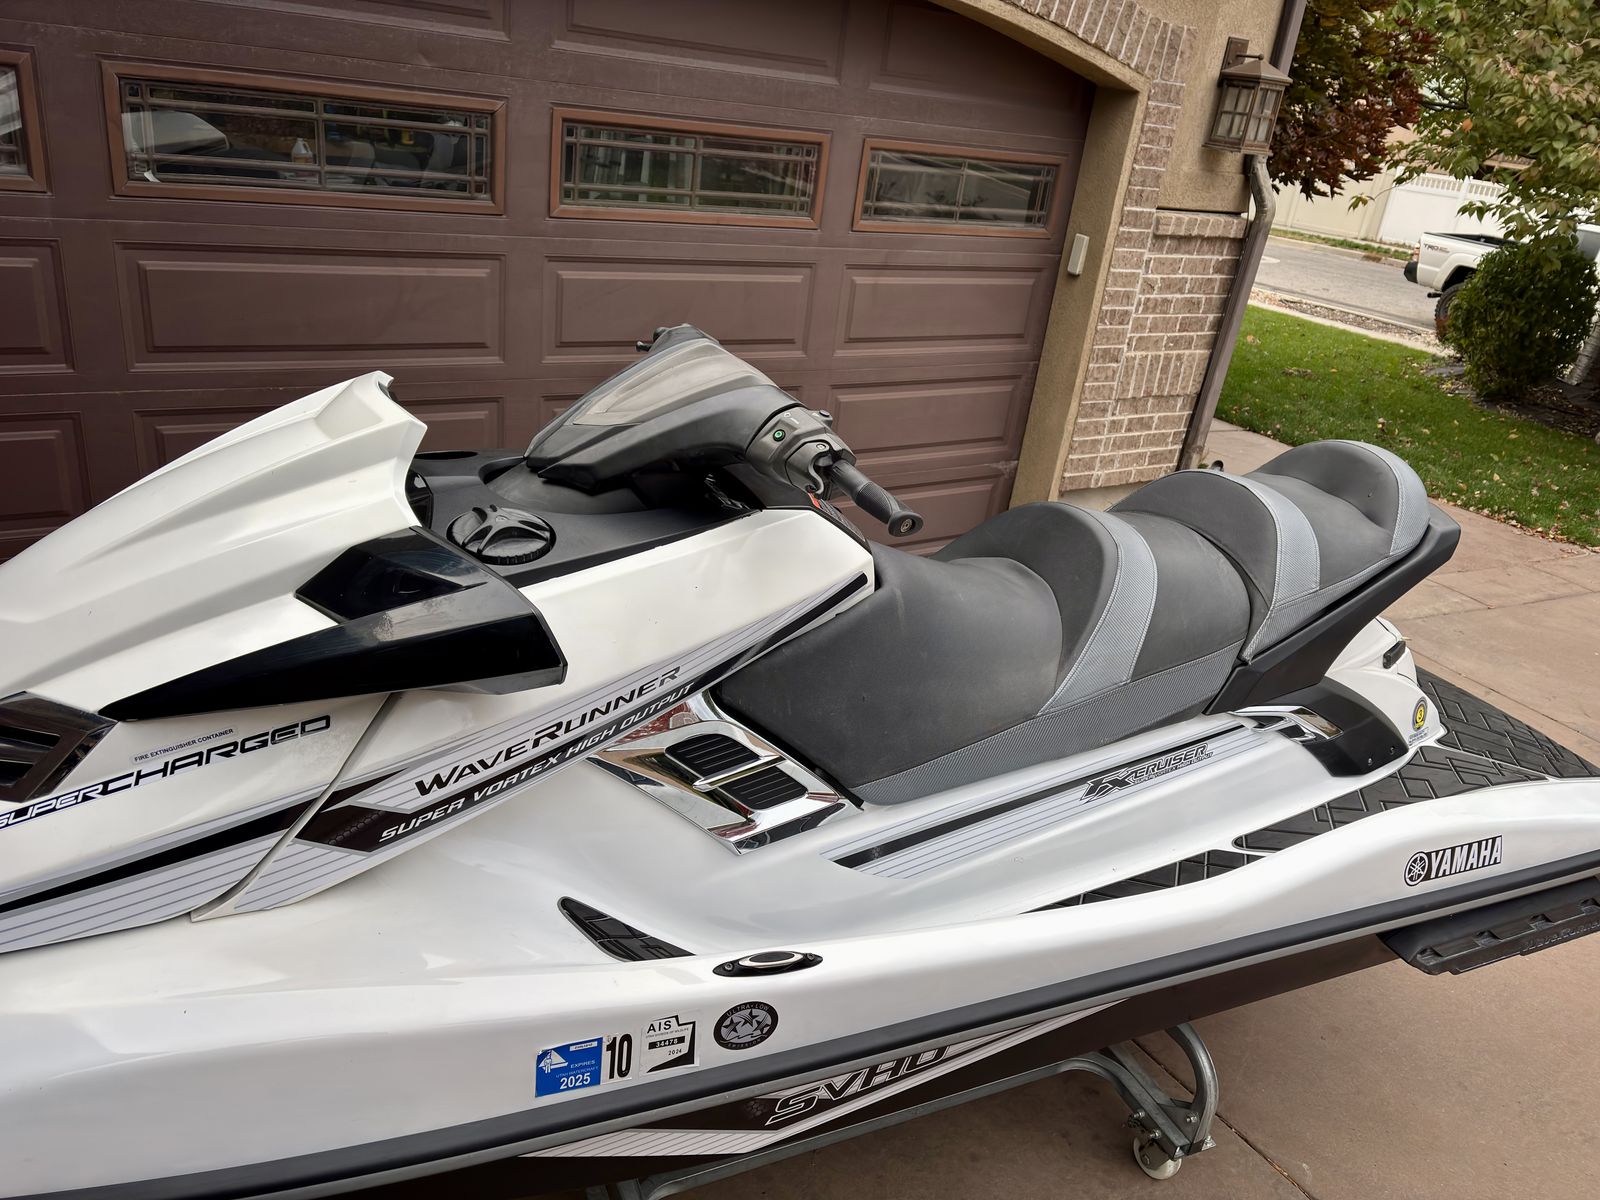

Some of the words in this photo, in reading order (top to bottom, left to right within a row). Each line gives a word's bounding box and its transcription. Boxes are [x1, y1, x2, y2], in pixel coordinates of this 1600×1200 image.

[134, 753, 149, 762] FIRE
[150, 739, 197, 757] EXTINGUISHER
[197, 728, 234, 743] CONTAINER
[379, 798, 465, 842] SUPER
[473, 755, 562, 801] VORTEX
[566, 725, 616, 757] HIGH
[620, 681, 695, 727] OUTPUT
[1133, 743, 1208, 779] CRUISER
[1430, 836, 1502, 879] YAMAHA
[647, 1020, 672, 1034] AIS
[570, 1060, 596, 1069] EXPIRES
[605, 1033, 633, 1080] 10
[560, 1072, 590, 1090] 2025
